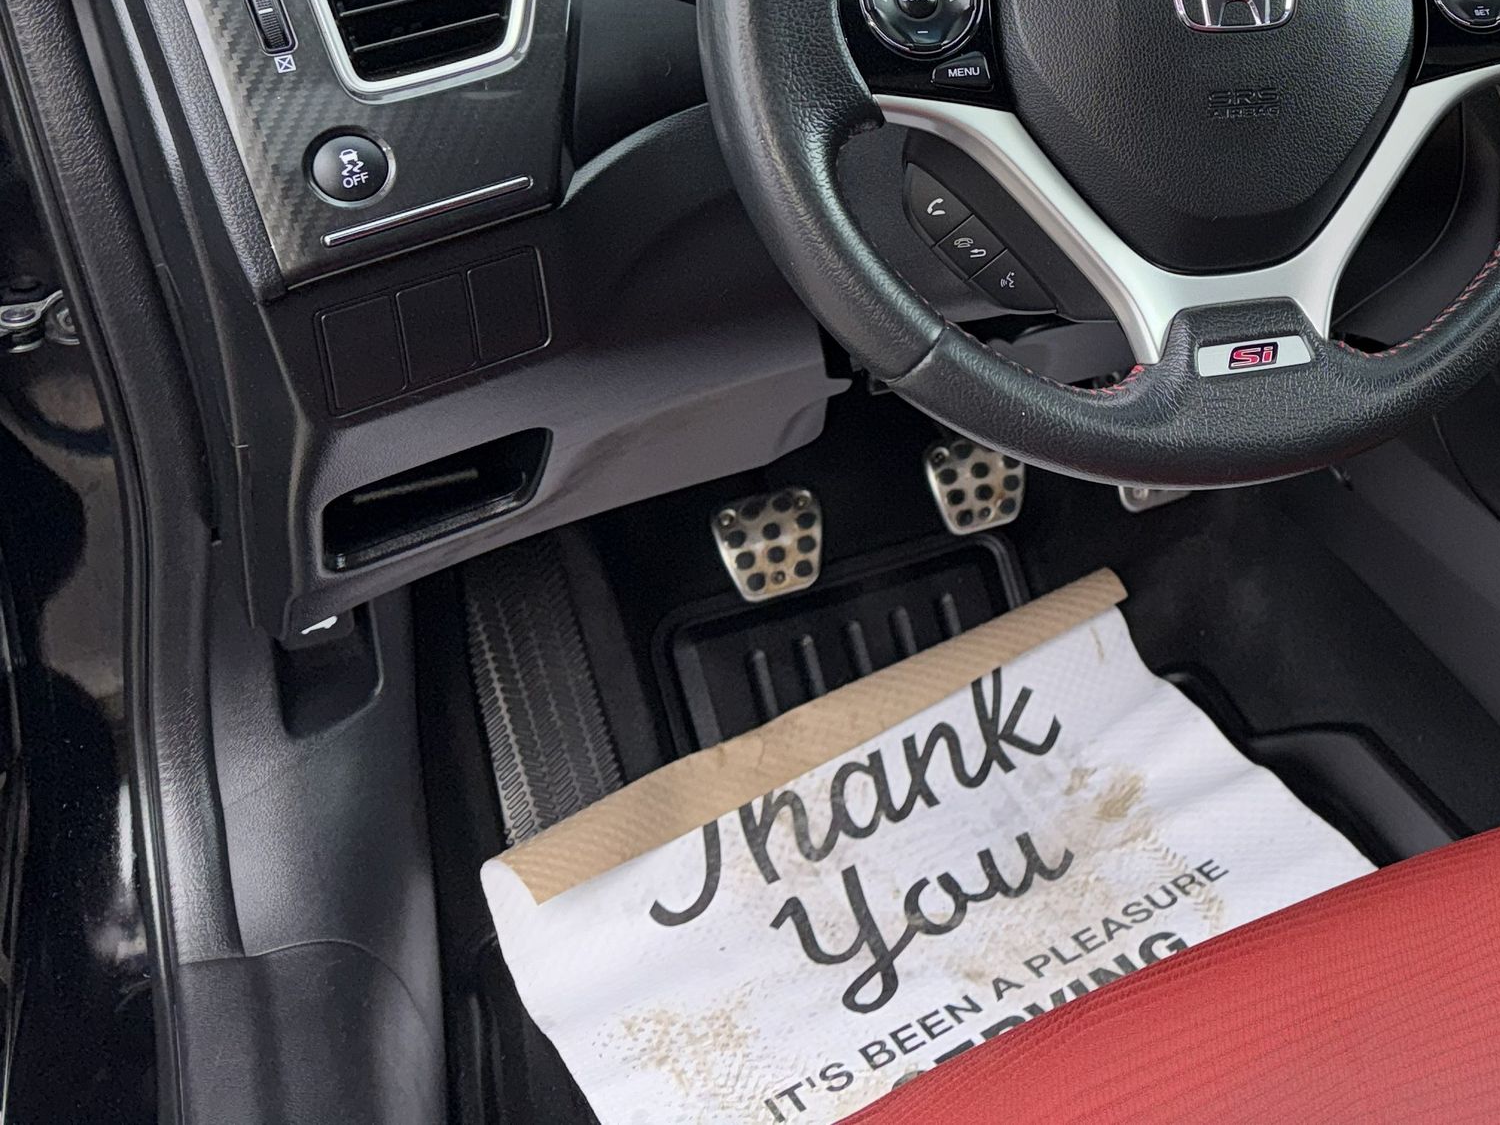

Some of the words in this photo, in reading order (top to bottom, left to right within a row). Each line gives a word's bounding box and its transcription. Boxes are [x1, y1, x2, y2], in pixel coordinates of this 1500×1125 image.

[947, 66, 981, 77] MENU
[342, 171, 369, 188] OFF
[1230, 346, 1274, 367] Si
[769, 831, 1075, 1013] You
[763, 1061, 855, 1123] IT'S
[858, 994, 984, 1071] BEEN
[991, 977, 1024, 1002] A
[1023, 858, 1229, 980] PLEASURE
